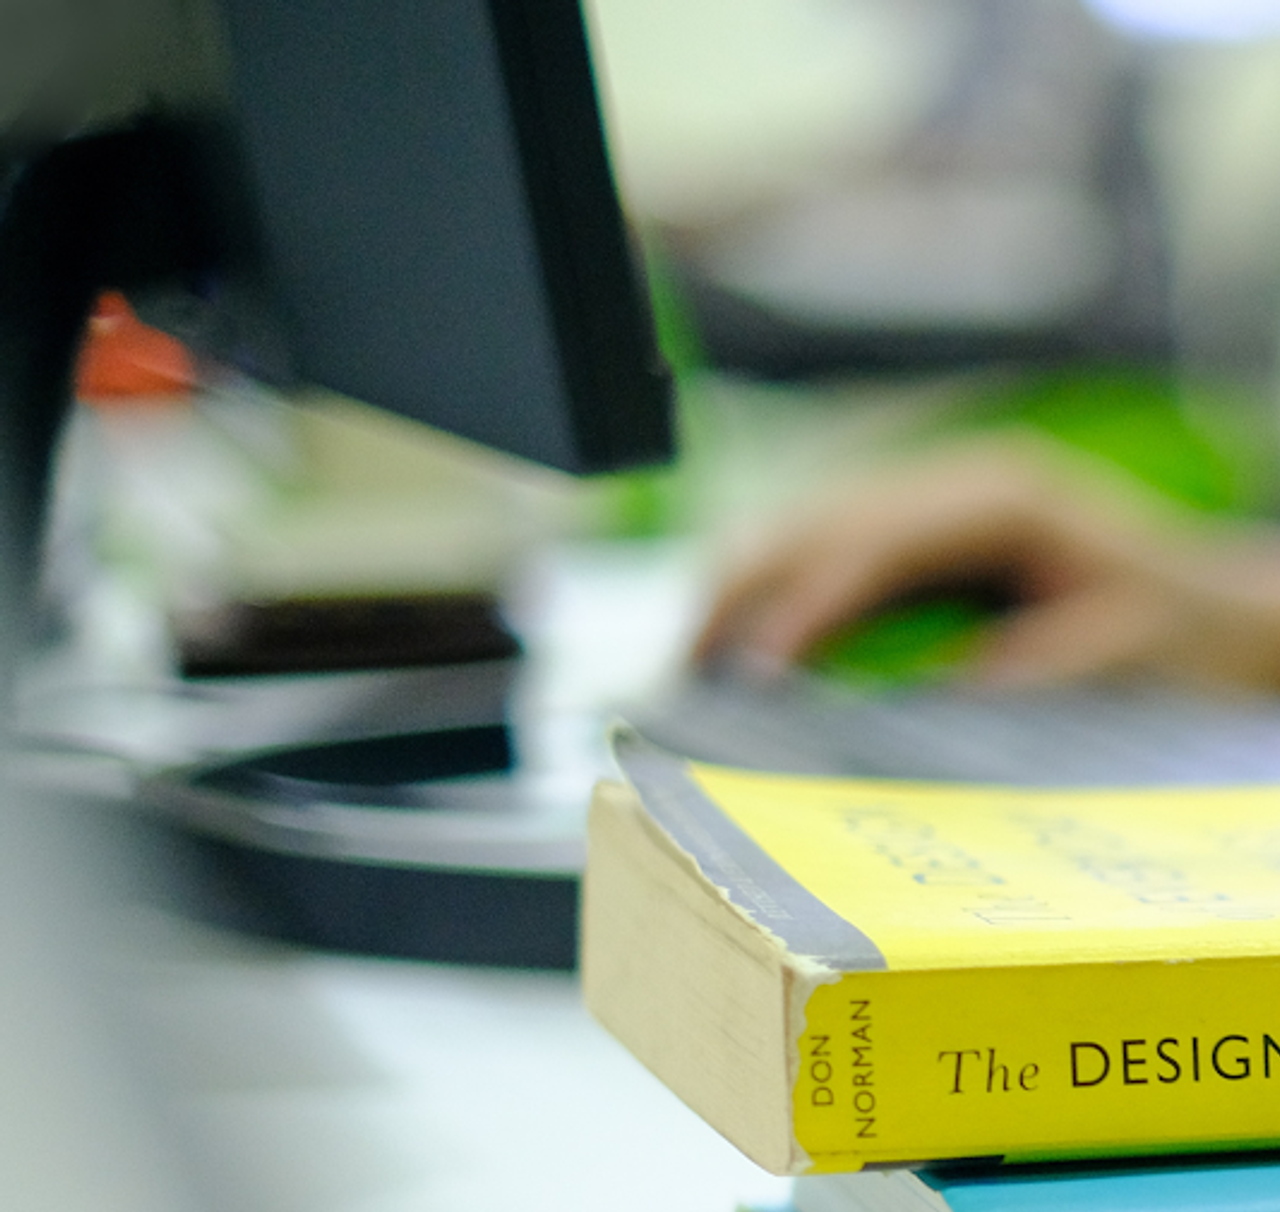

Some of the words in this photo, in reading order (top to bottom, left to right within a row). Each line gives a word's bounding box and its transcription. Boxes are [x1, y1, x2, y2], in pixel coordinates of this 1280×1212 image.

[809, 1034, 835, 1108] DON
[849, 998, 878, 1140] NORMAN
[937, 1046, 1040, 1095] The
